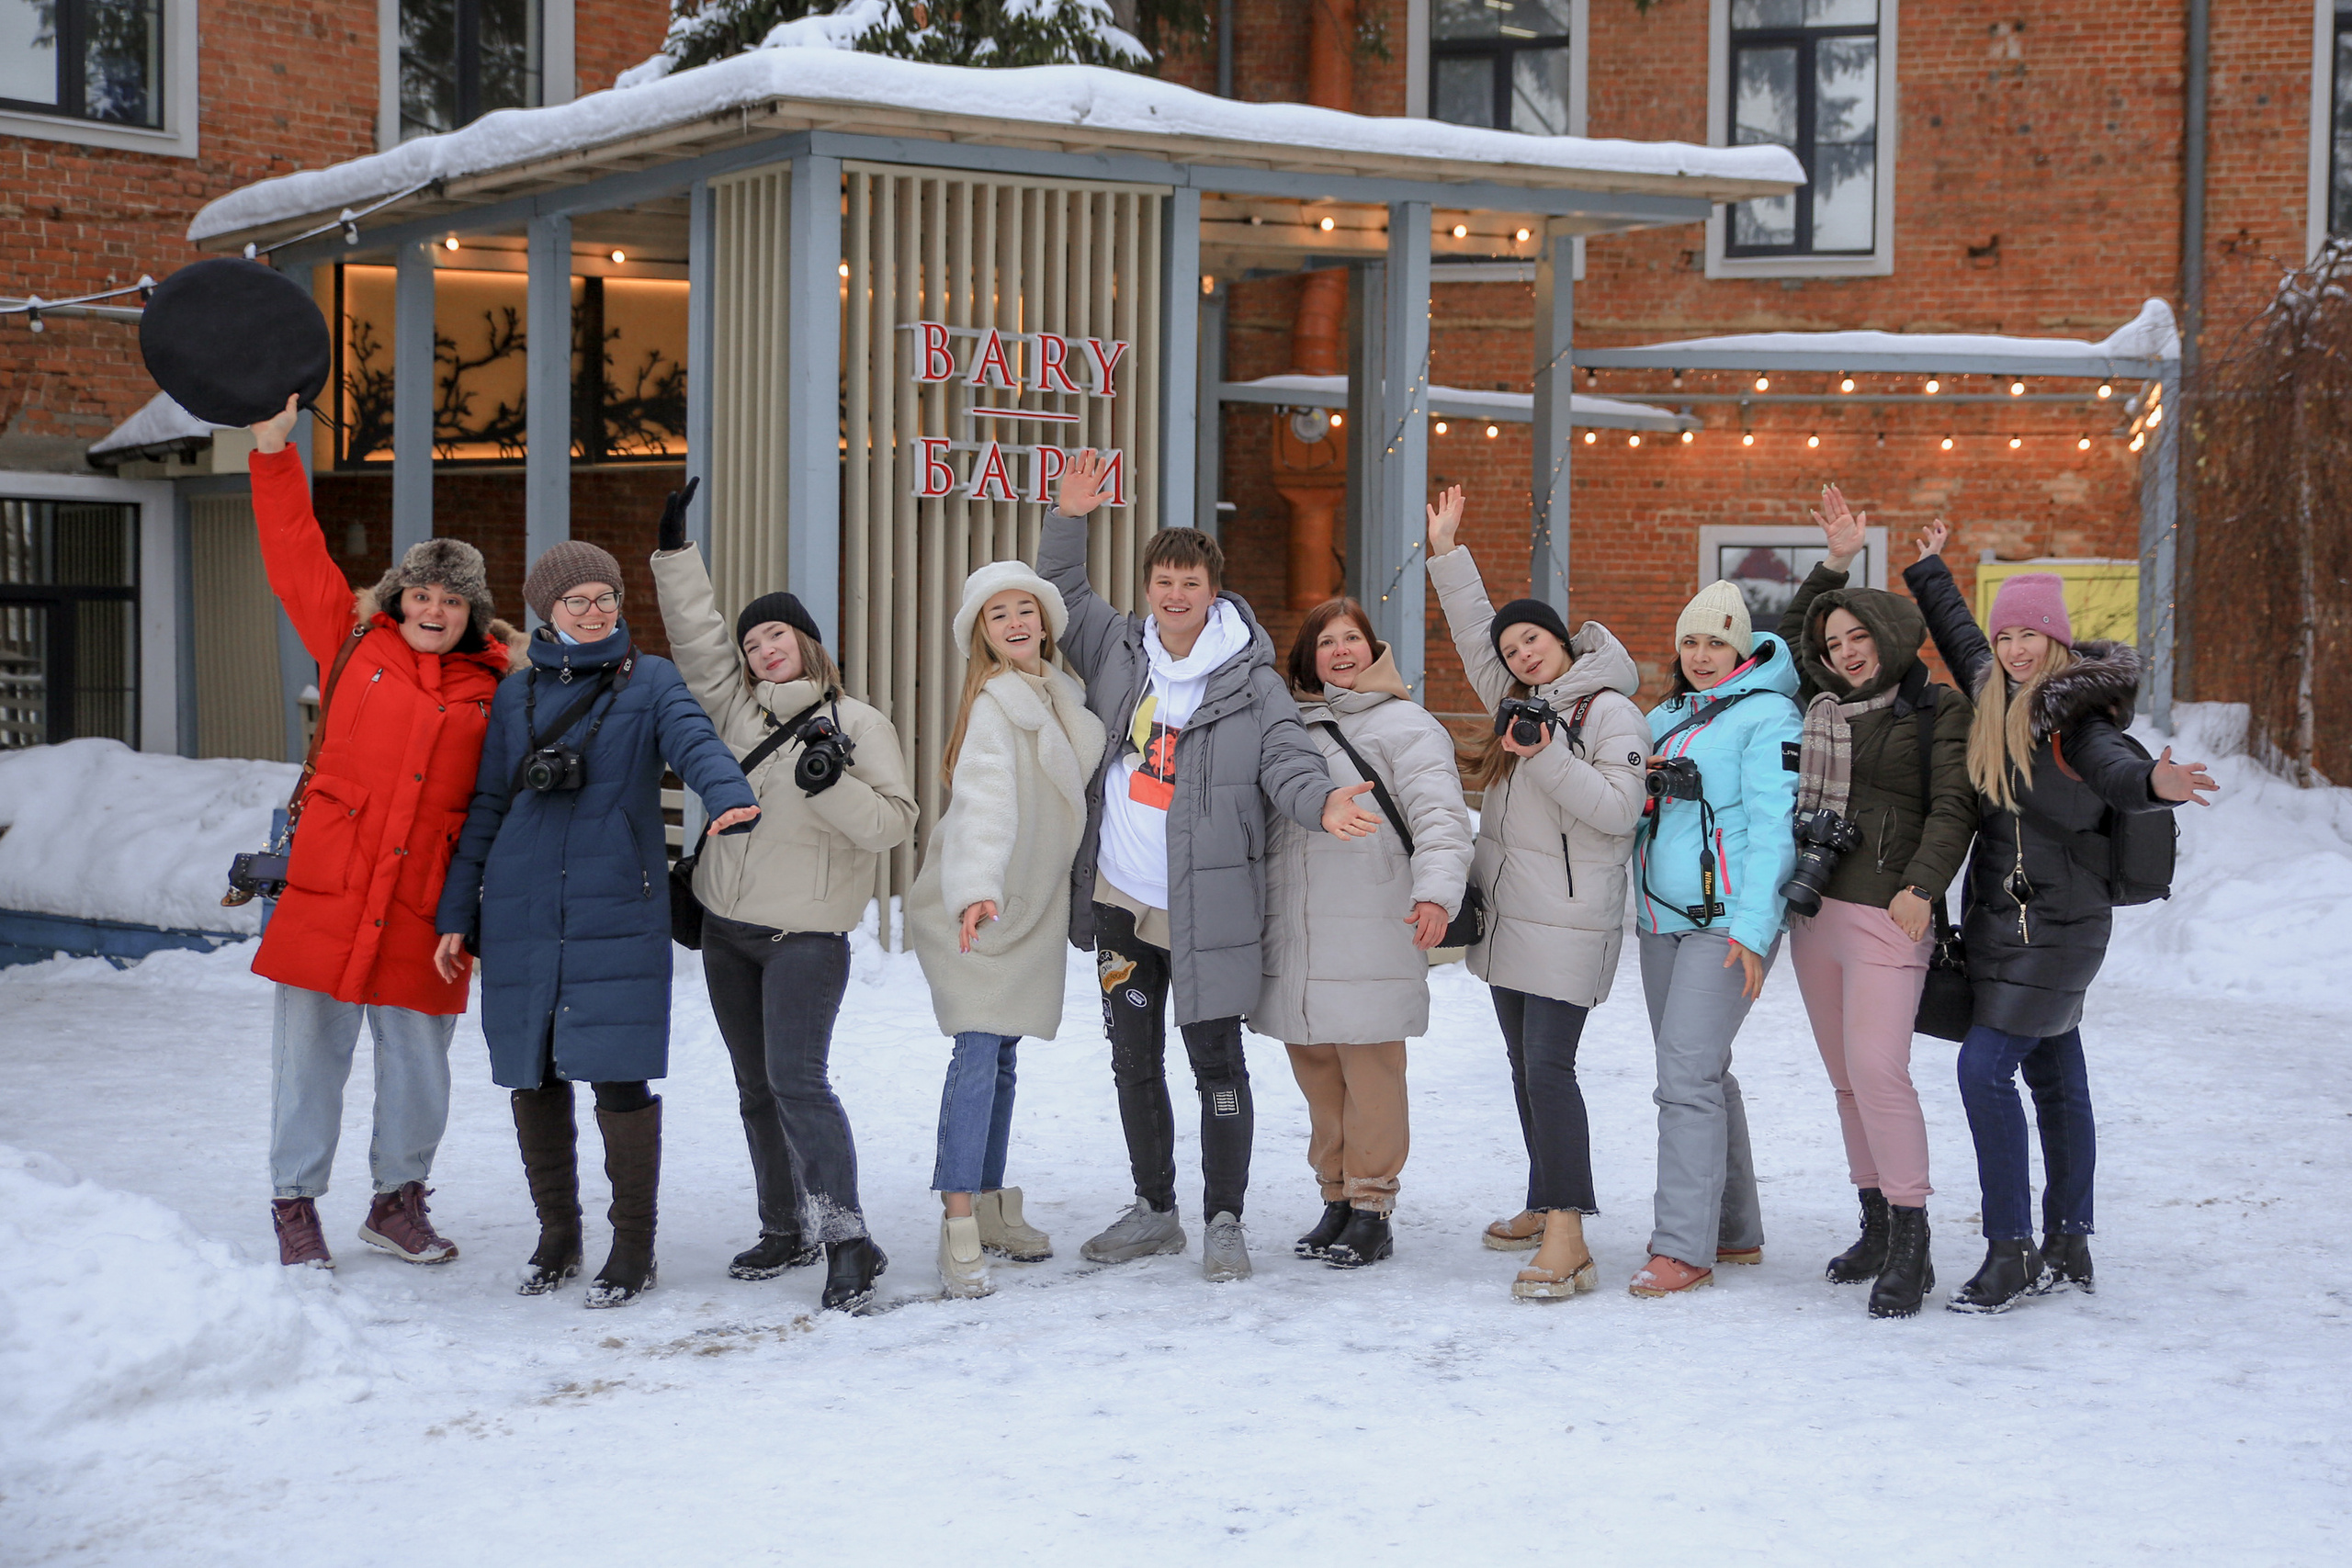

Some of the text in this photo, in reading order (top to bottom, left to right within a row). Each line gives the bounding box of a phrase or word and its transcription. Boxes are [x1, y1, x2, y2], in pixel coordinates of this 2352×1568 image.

[912, 322, 1129, 398] BARY
[1575, 702, 1588, 720] EOS
[1704, 871, 1713, 895] Nikon
